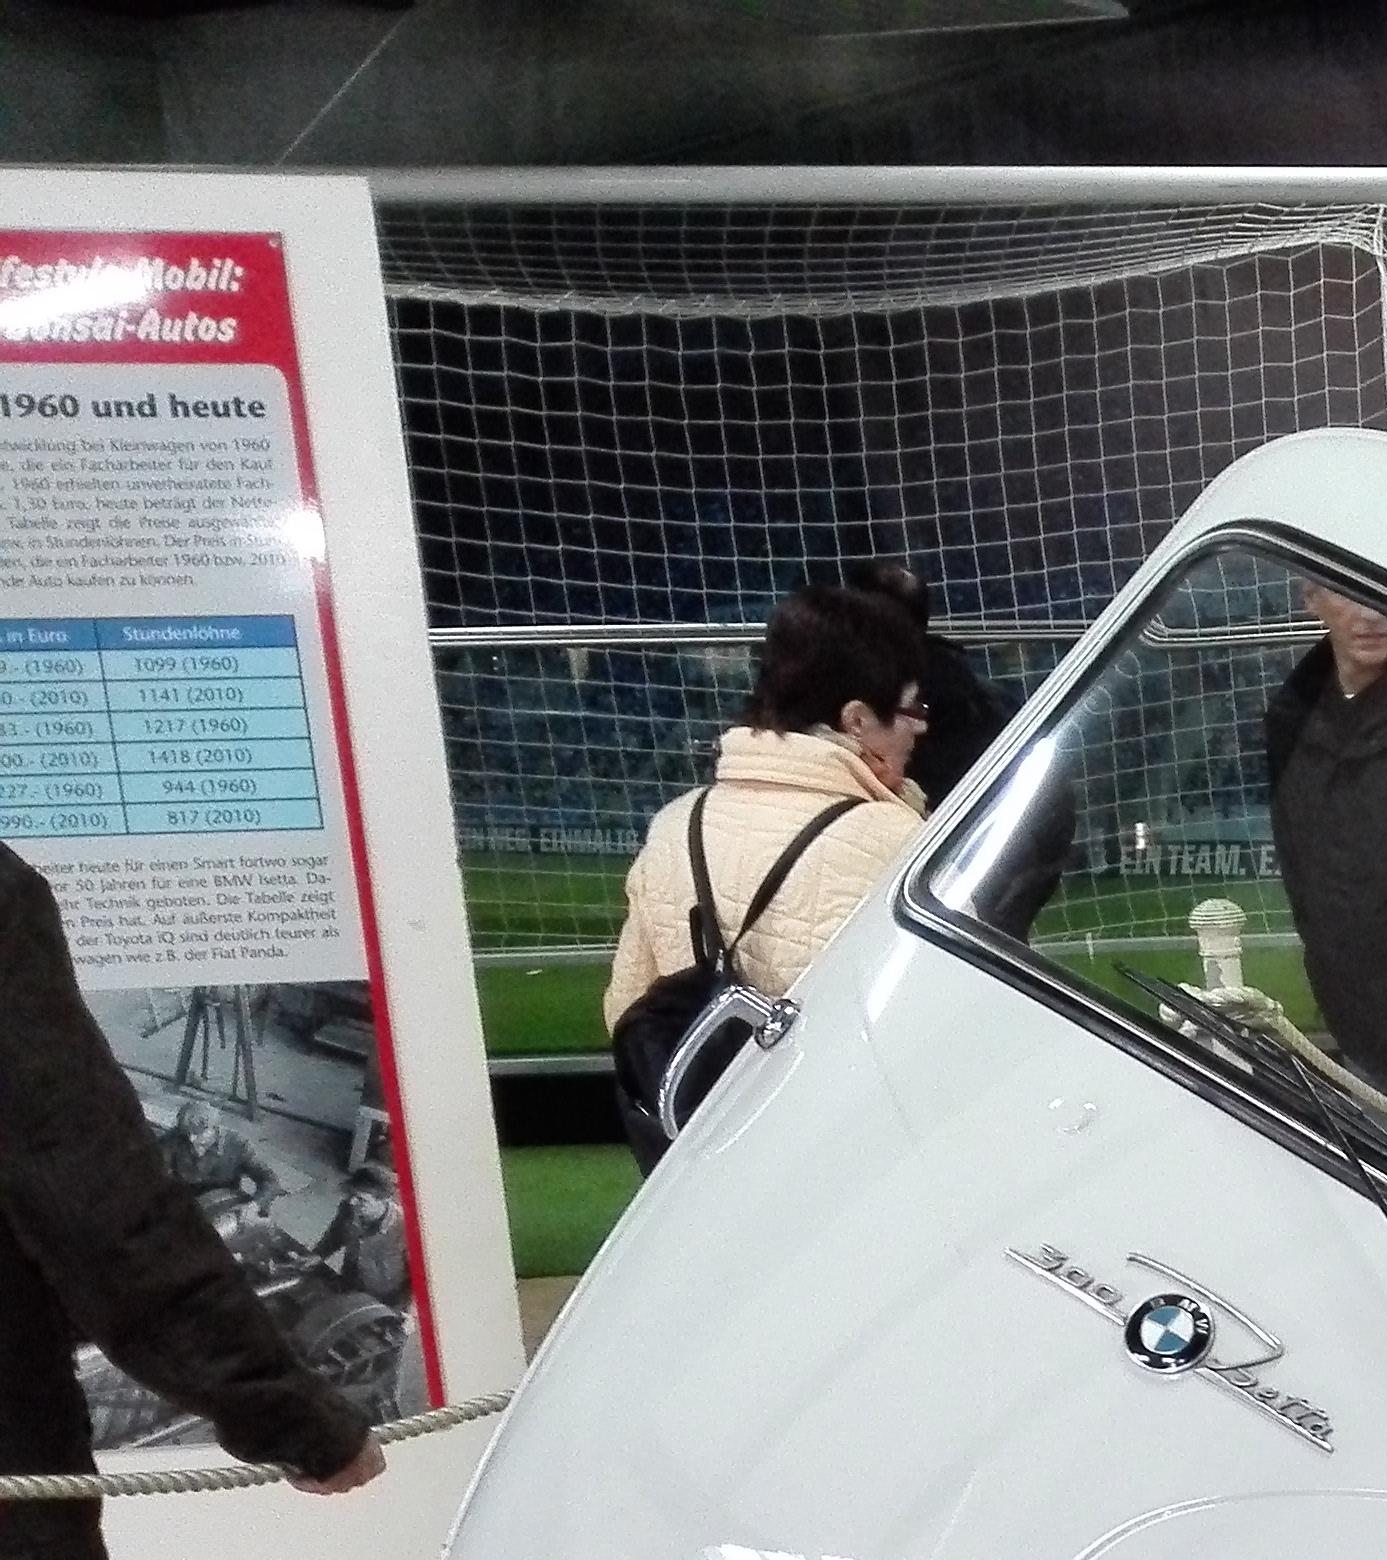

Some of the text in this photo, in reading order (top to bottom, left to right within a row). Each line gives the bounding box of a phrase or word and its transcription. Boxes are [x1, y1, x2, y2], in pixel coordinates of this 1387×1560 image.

[0, 391, 267, 419] 1960 und heute
[200, 441, 228, 452] von
[233, 438, 271, 451] 1960
[80, 459, 172, 471] Facharbeiter
[206, 459, 235, 471] den
[28, 627, 68, 643] Euro
[122, 625, 242, 642] Stundenlöhne
[25, 658, 84, 675] (1960)
[134, 657, 176, 672] 1099
[183, 656, 239, 673] (1960)
[31, 690, 89, 707] (2010)
[139, 688, 180, 702] 1141
[187, 686, 244, 703] (2010)
[36, 721, 94, 738] (1960)
[145, 719, 184, 734] 1217
[192, 718, 248, 734] (1960)
[40, 751, 99, 769] (2010)
[150, 749, 190, 764] 1418
[197, 748, 253, 765] (2010)
[46, 782, 103, 800] (1960)
[162, 779, 195, 793] 944
[201, 778, 257, 796] (1960)
[50, 813, 108, 831] (2010)
[167, 810, 199, 824] 817
[205, 809, 261, 826] (2010)
[193, 857, 236, 869] Smart
[240, 856, 286, 868] fortwo
[291, 856, 328, 870] sogar
[1168, 844, 1246, 876] TEAM.
[214, 874, 253, 887] BMW
[87, 896, 140, 909] Technik
[146, 895, 210, 911] geboten.
[216, 893, 241, 905] Die
[245, 890, 295, 904] Tabelle
[300, 889, 335, 905] zeigt
[80, 915, 114, 928] Preis
[152, 913, 176, 926] Auf
[247, 907, 337, 924] Kompaktheit
[104, 932, 153, 948] Toyota
[180, 929, 208, 943] sind
[213, 928, 271, 942] deutlich
[275, 927, 316, 940] teurer
[322, 925, 341, 938] als
[126, 951, 151, 963] wie
[184, 947, 208, 961] der
[212, 946, 236, 959] Fiat
[241, 943, 289, 959] Panda.
